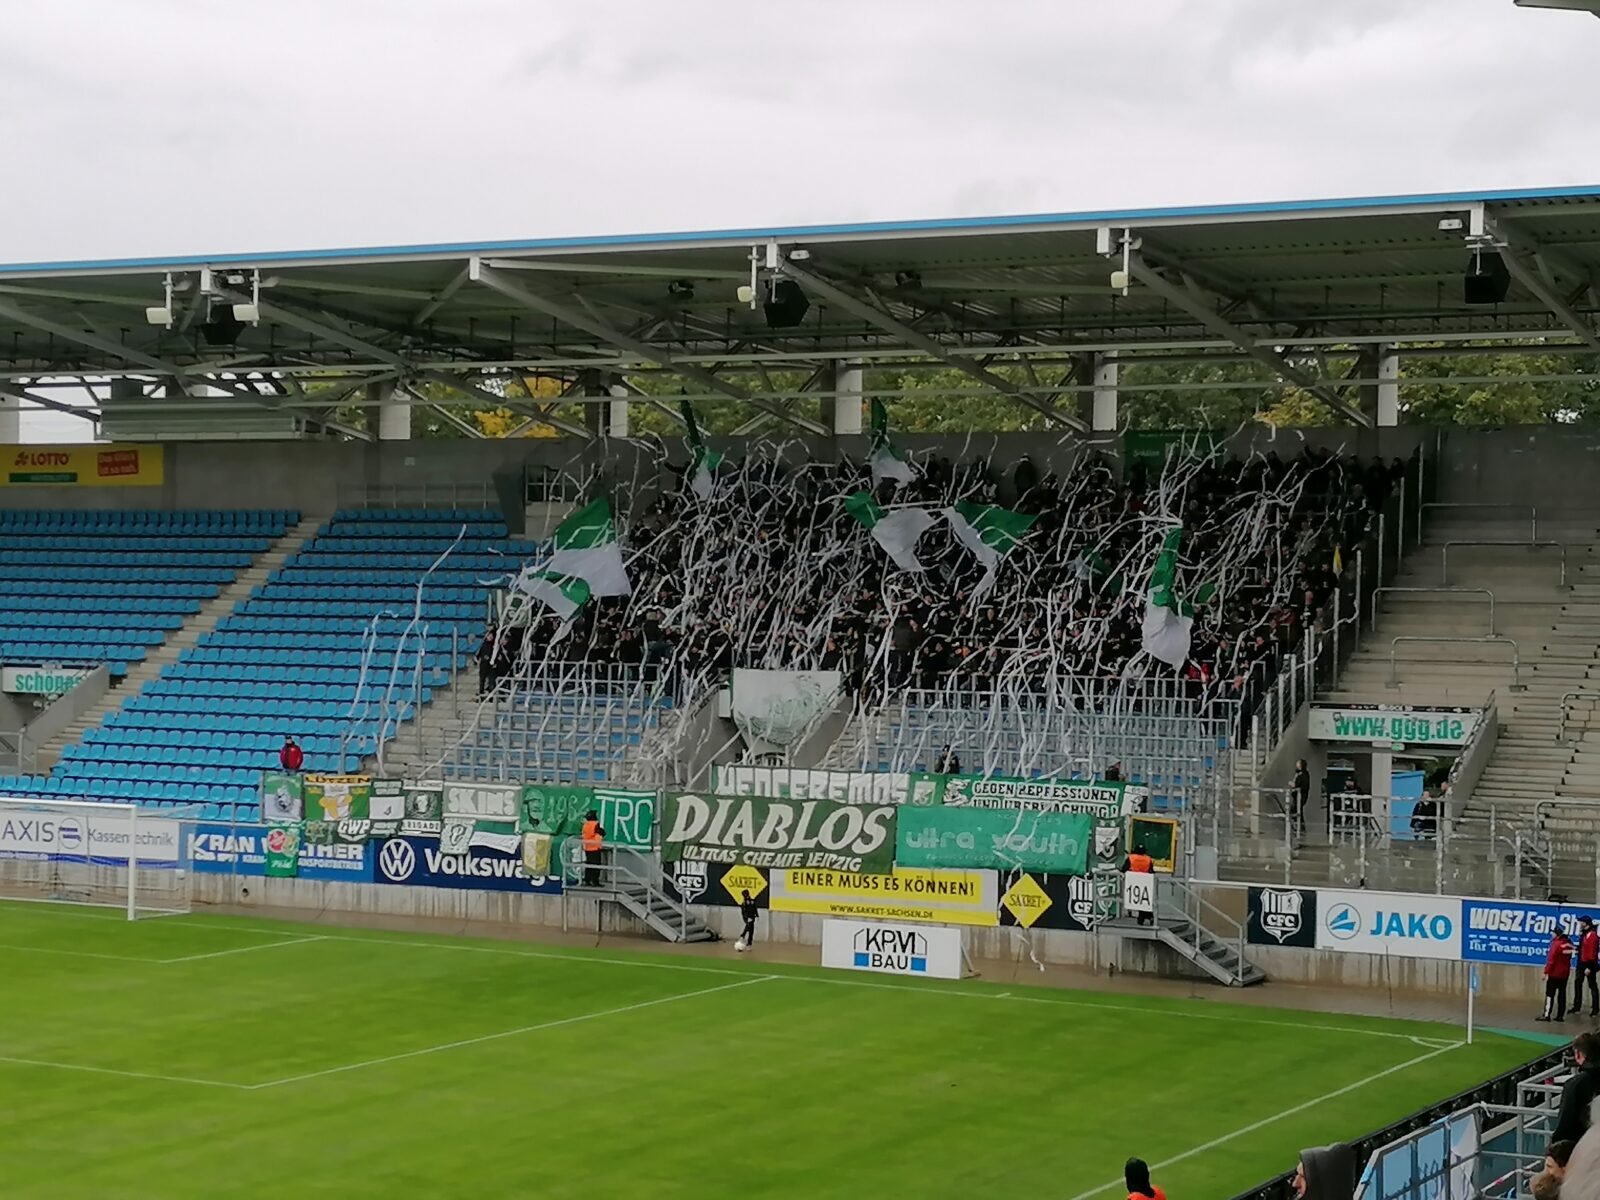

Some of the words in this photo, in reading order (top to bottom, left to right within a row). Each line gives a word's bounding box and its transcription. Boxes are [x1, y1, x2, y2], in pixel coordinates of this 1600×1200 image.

[31, 453, 70, 466] LOTTO
[1335, 716, 1464, 741] www.ggg.de
[974, 782, 1014, 795] GEGEN
[448, 787, 515, 815] SKINS
[2, 820, 54, 843] AXIS
[88, 827, 174, 847] Kassenechnik
[338, 819, 371, 835] GWP
[666, 795, 895, 855] DIABLOS
[187, 833, 255, 860] KRAN
[905, 827, 975, 850] ultra
[992, 831, 1079, 857] youth
[682, 845, 738, 863] ULTRAS
[743, 851, 802, 868] CHEMIE
[806, 852, 862, 872] LEIPZIG
[678, 875, 702, 888] CFC
[792, 871, 834, 888] EINER
[838, 873, 881, 891] MUSS
[884, 876, 899, 891] ES
[904, 875, 975, 897] KÖNNEN!
[1126, 884, 1150, 906] 19A
[1266, 914, 1296, 927] CFC
[1370, 910, 1452, 940] JAKO
[1469, 907, 1524, 932] WOSZ
[1525, 911, 1557, 935] Fan
[866, 928, 916, 954] KPM
[1469, 939, 1487, 951] Ihr
[872, 953, 908, 970] BAU
